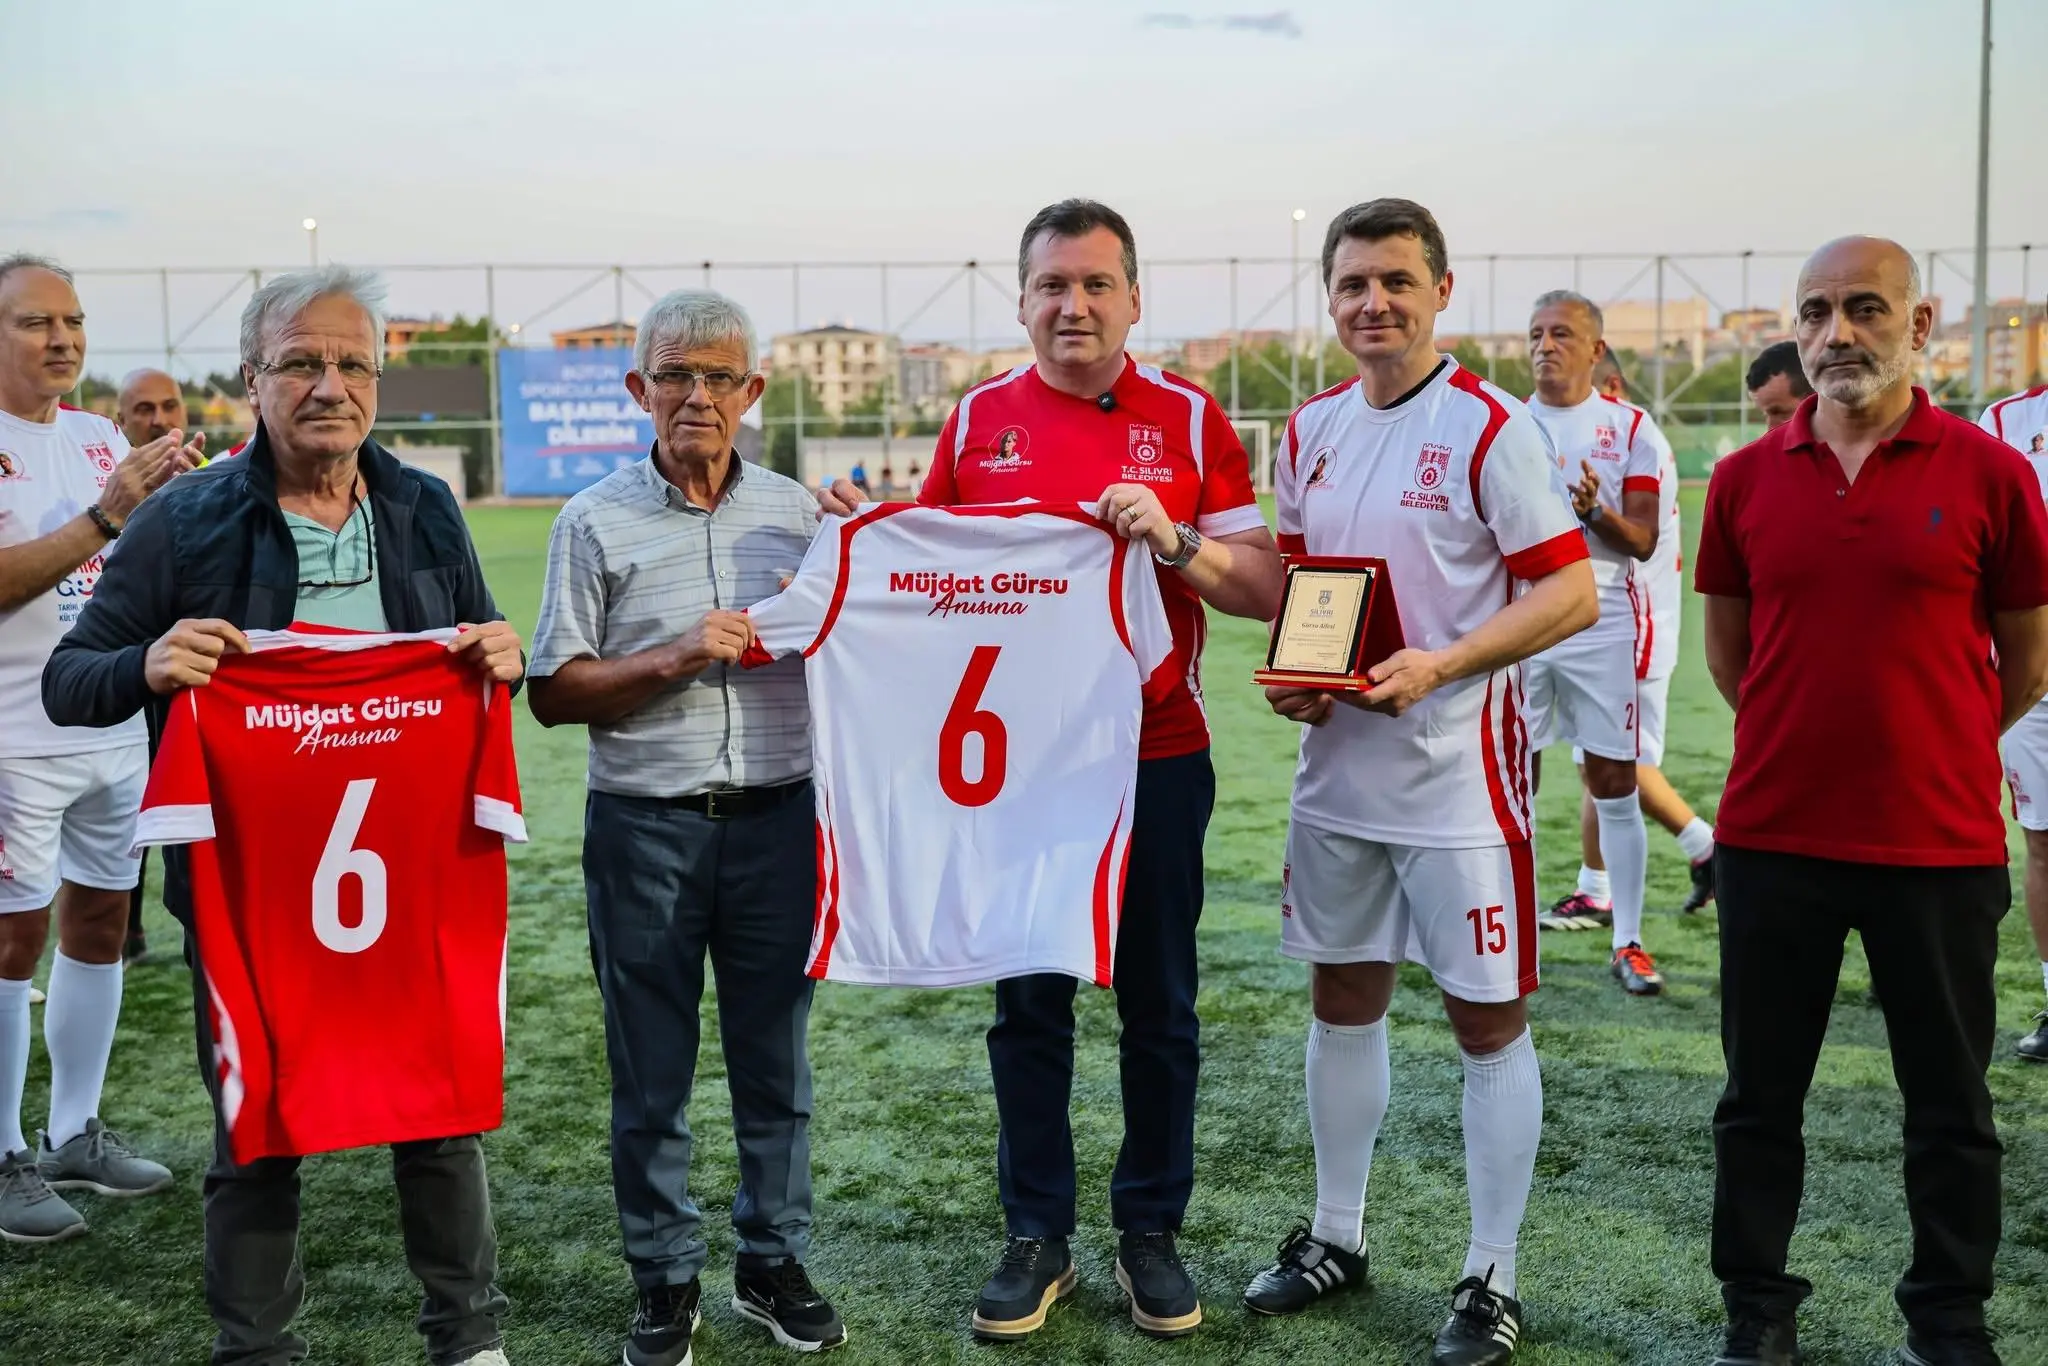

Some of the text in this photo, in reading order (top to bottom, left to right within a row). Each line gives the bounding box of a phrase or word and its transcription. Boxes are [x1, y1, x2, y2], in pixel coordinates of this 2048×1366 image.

[528, 401, 650, 423] BAŞARILA
[1403, 491, 1416, 500] T.C.
[890, 572, 1068, 598] Müjdat Gürsu
[928, 589, 1028, 618] Anısına
[245, 696, 442, 732] Müjdat Gürsu
[938, 645, 1007, 808] 6
[1625, 702, 1634, 730] 2
[294, 720, 402, 755] Anısına
[312, 778, 387, 953] 6
[1466, 904, 1507, 956] 15
